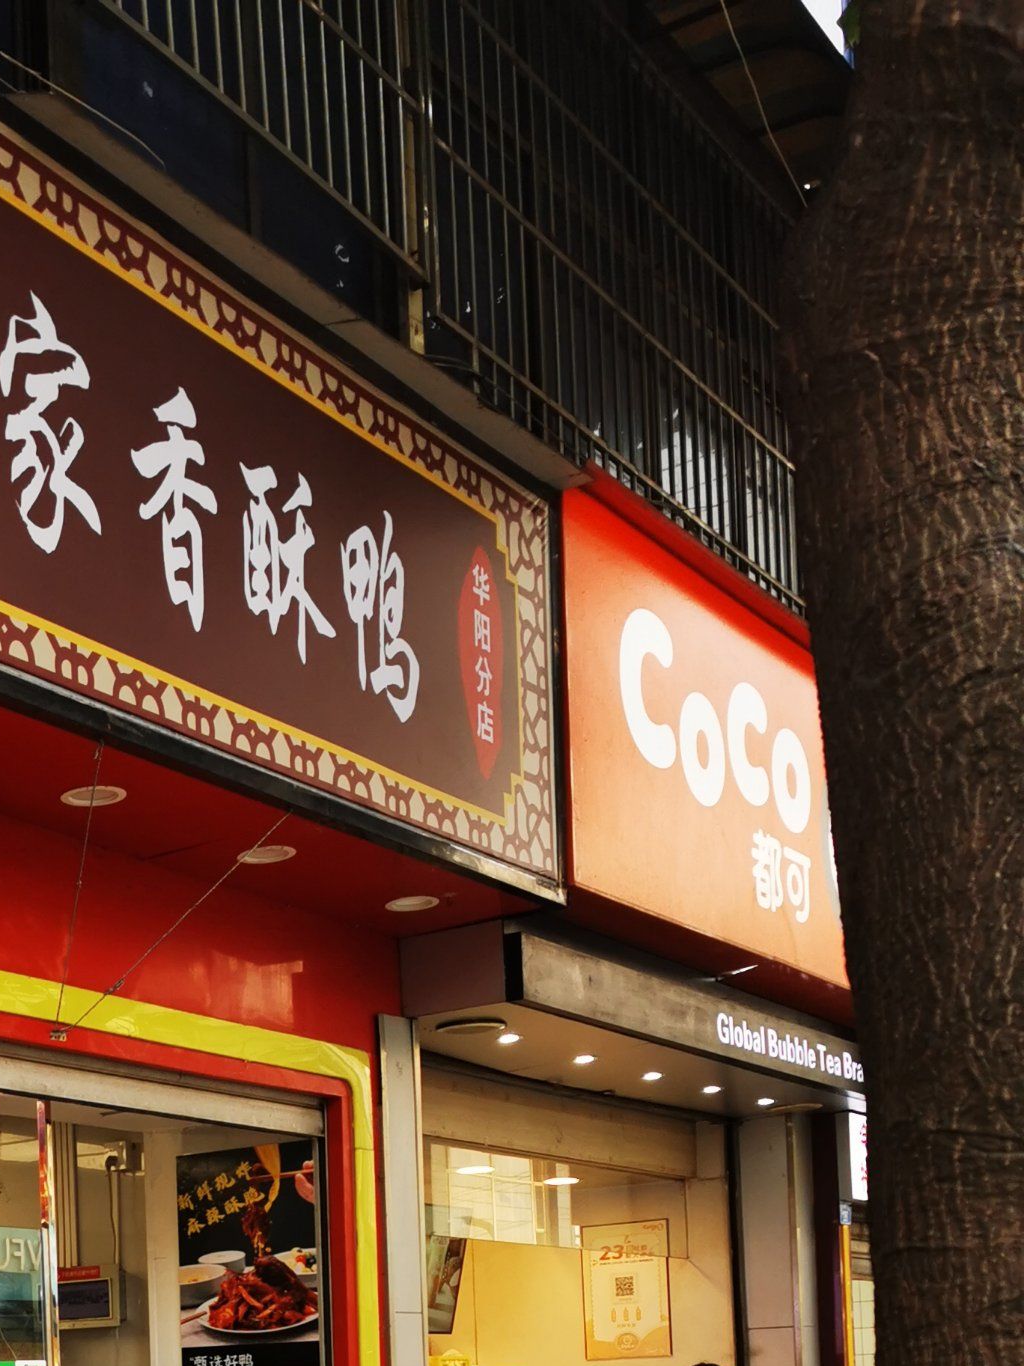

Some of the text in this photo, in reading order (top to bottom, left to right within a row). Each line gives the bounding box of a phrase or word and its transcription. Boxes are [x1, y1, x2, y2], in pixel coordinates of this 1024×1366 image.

[472, 563, 495, 745] 华阳分店
[619, 607, 812, 834] CoCo
[751, 828, 812, 924] 都可
[716, 1012, 766, 1055] Global
[767, 1028, 817, 1069] Bubble
[817, 1043, 842, 1077] Tea
